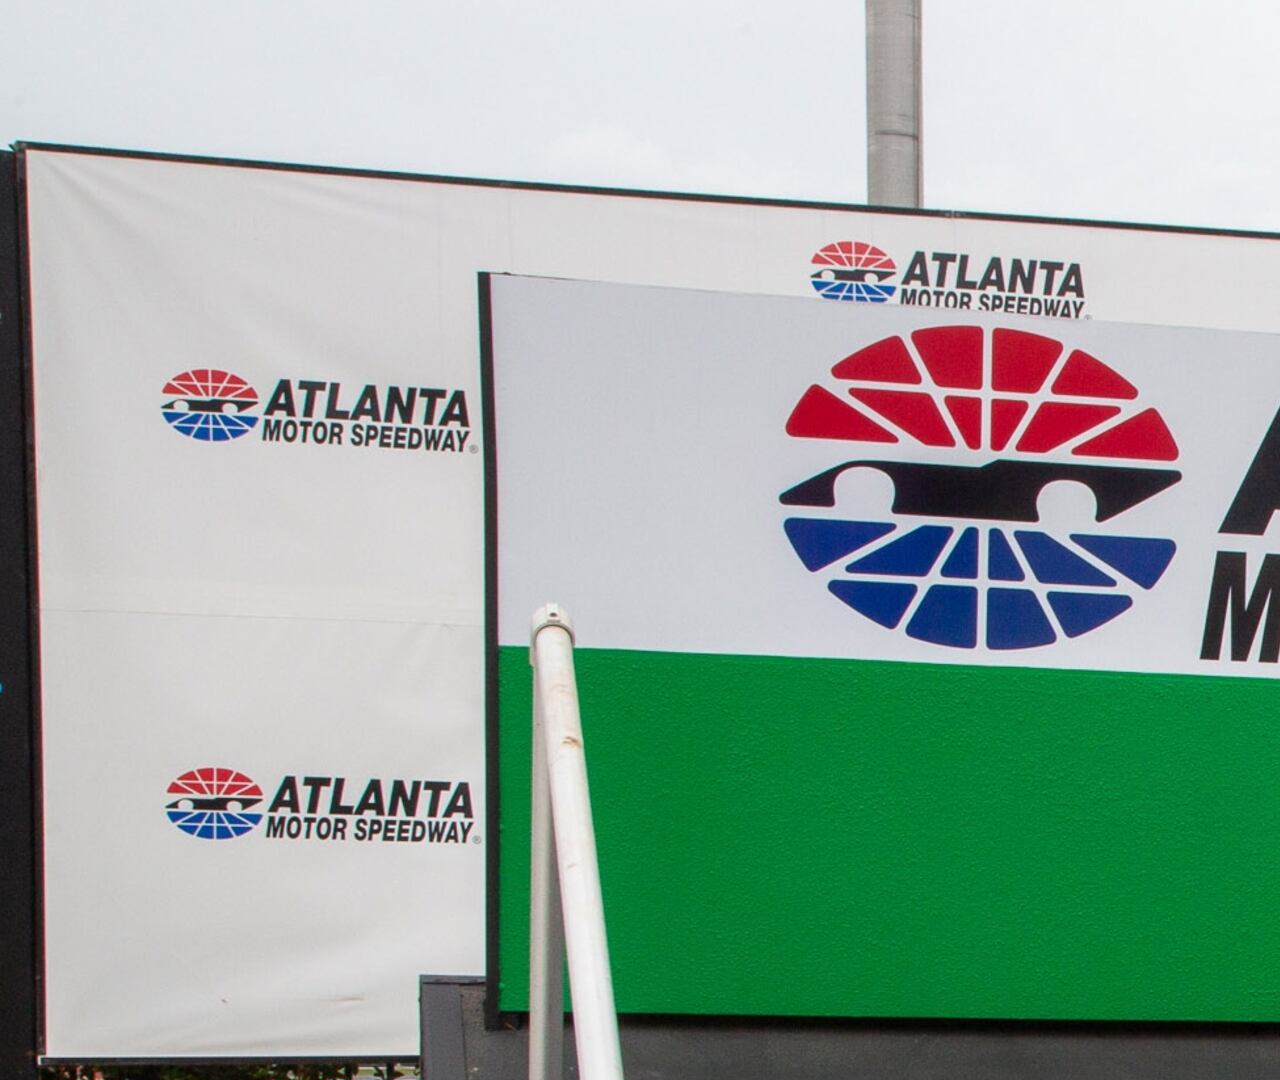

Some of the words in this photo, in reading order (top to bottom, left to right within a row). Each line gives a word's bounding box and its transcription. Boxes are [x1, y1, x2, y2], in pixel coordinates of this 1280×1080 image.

[902, 250, 1085, 298] ATLANTA
[900, 288, 971, 311] MOTOR
[978, 292, 1085, 319] SPEEDWAY
[264, 378, 470, 428] ATLANTA
[262, 418, 344, 445] MOTOR
[350, 423, 470, 453] SPEEDWAY
[267, 776, 474, 819] ATLANTA
[265, 815, 348, 841] MOTOR
[353, 818, 474, 844] SPEEDWAY
